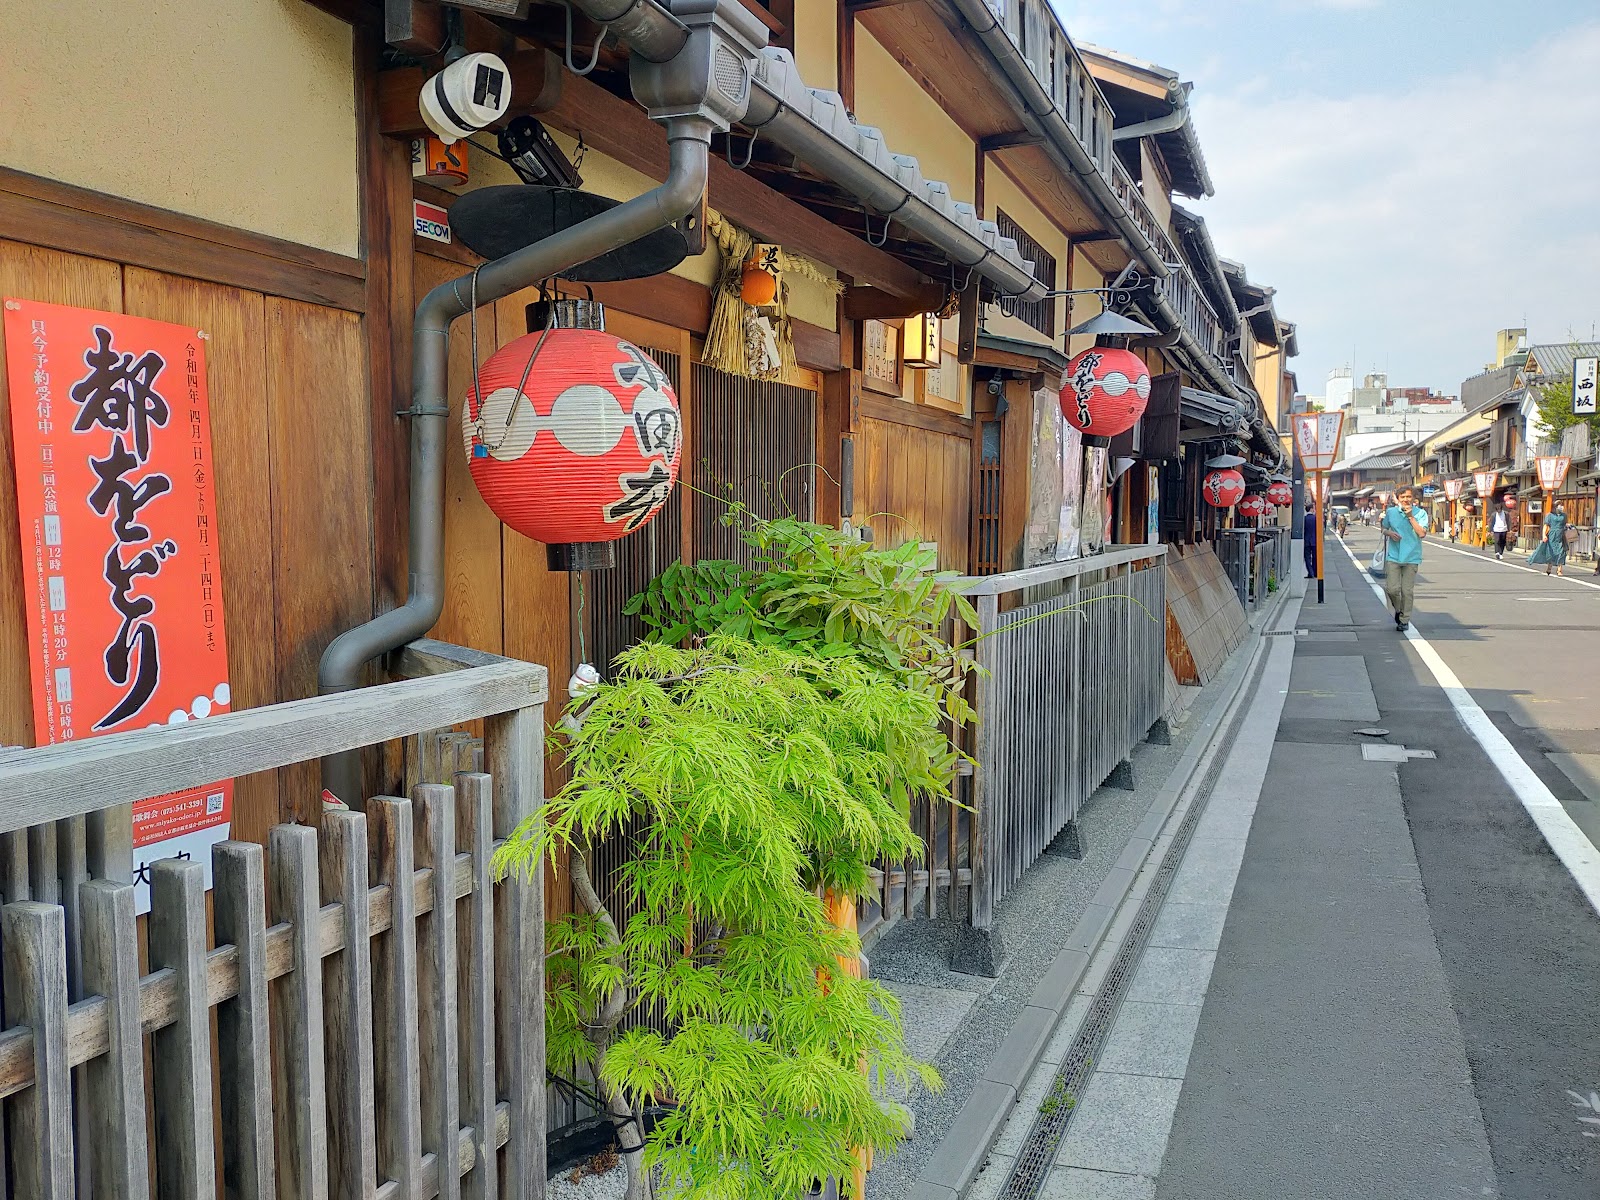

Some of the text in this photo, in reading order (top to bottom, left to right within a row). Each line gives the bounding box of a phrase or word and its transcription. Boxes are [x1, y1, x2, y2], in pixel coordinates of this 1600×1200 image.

[416, 218, 449, 240] SECOM
[31, 319, 54, 435] 只今予約受付中
[1075, 352, 1104, 428] 都をどり
[69, 324, 177, 732] 都をどり
[59, 703, 73, 743] 16時40
